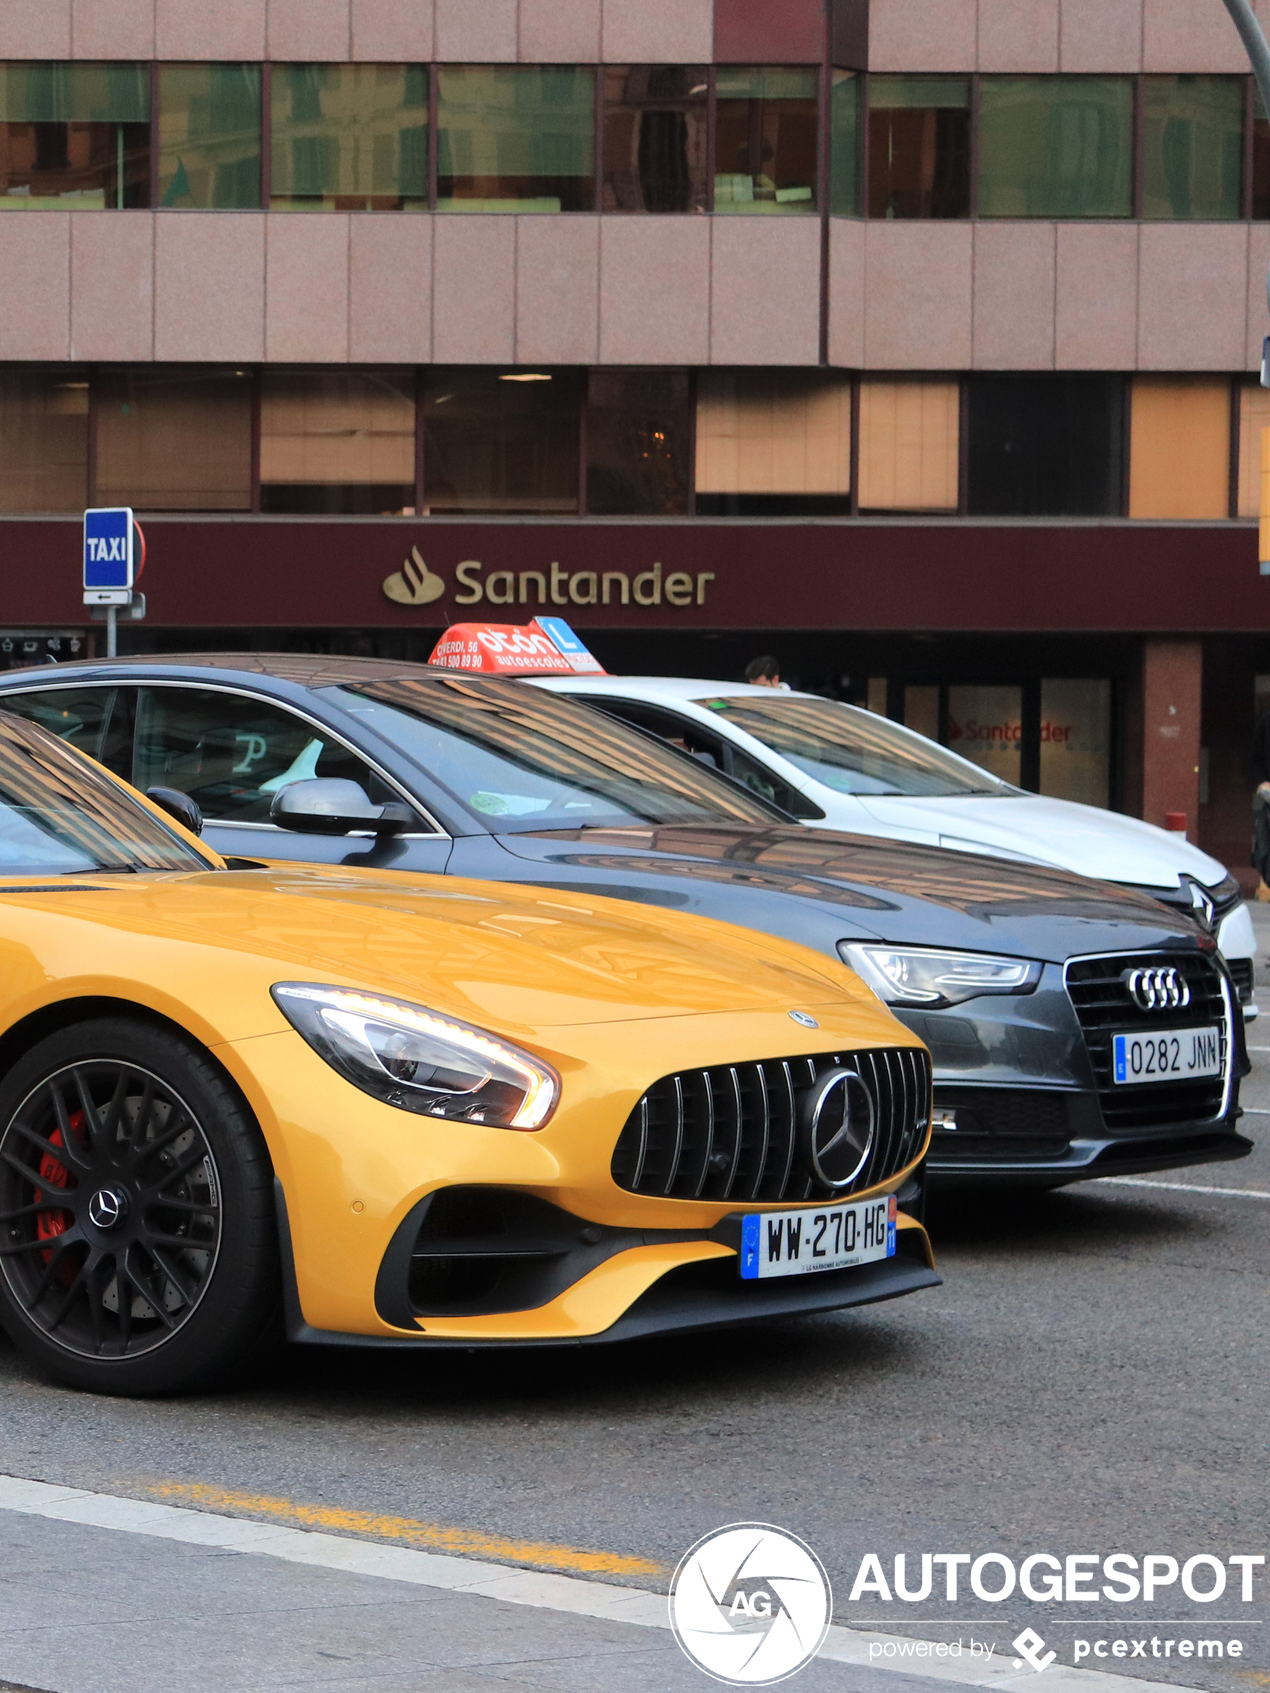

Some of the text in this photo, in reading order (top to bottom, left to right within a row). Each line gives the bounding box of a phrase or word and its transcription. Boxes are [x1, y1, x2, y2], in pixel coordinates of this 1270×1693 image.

[87, 537, 126, 561] TAXI
[455, 560, 715, 605] Santander
[548, 623, 578, 649] L
[468, 641, 478, 653] 56
[461, 655, 471, 668] 89
[472, 655, 483, 668] 90
[495, 655, 570, 669] autoescoles
[1131, 1033, 1217, 1075] 0282 JNN
[747, 1253, 754, 1267] F
